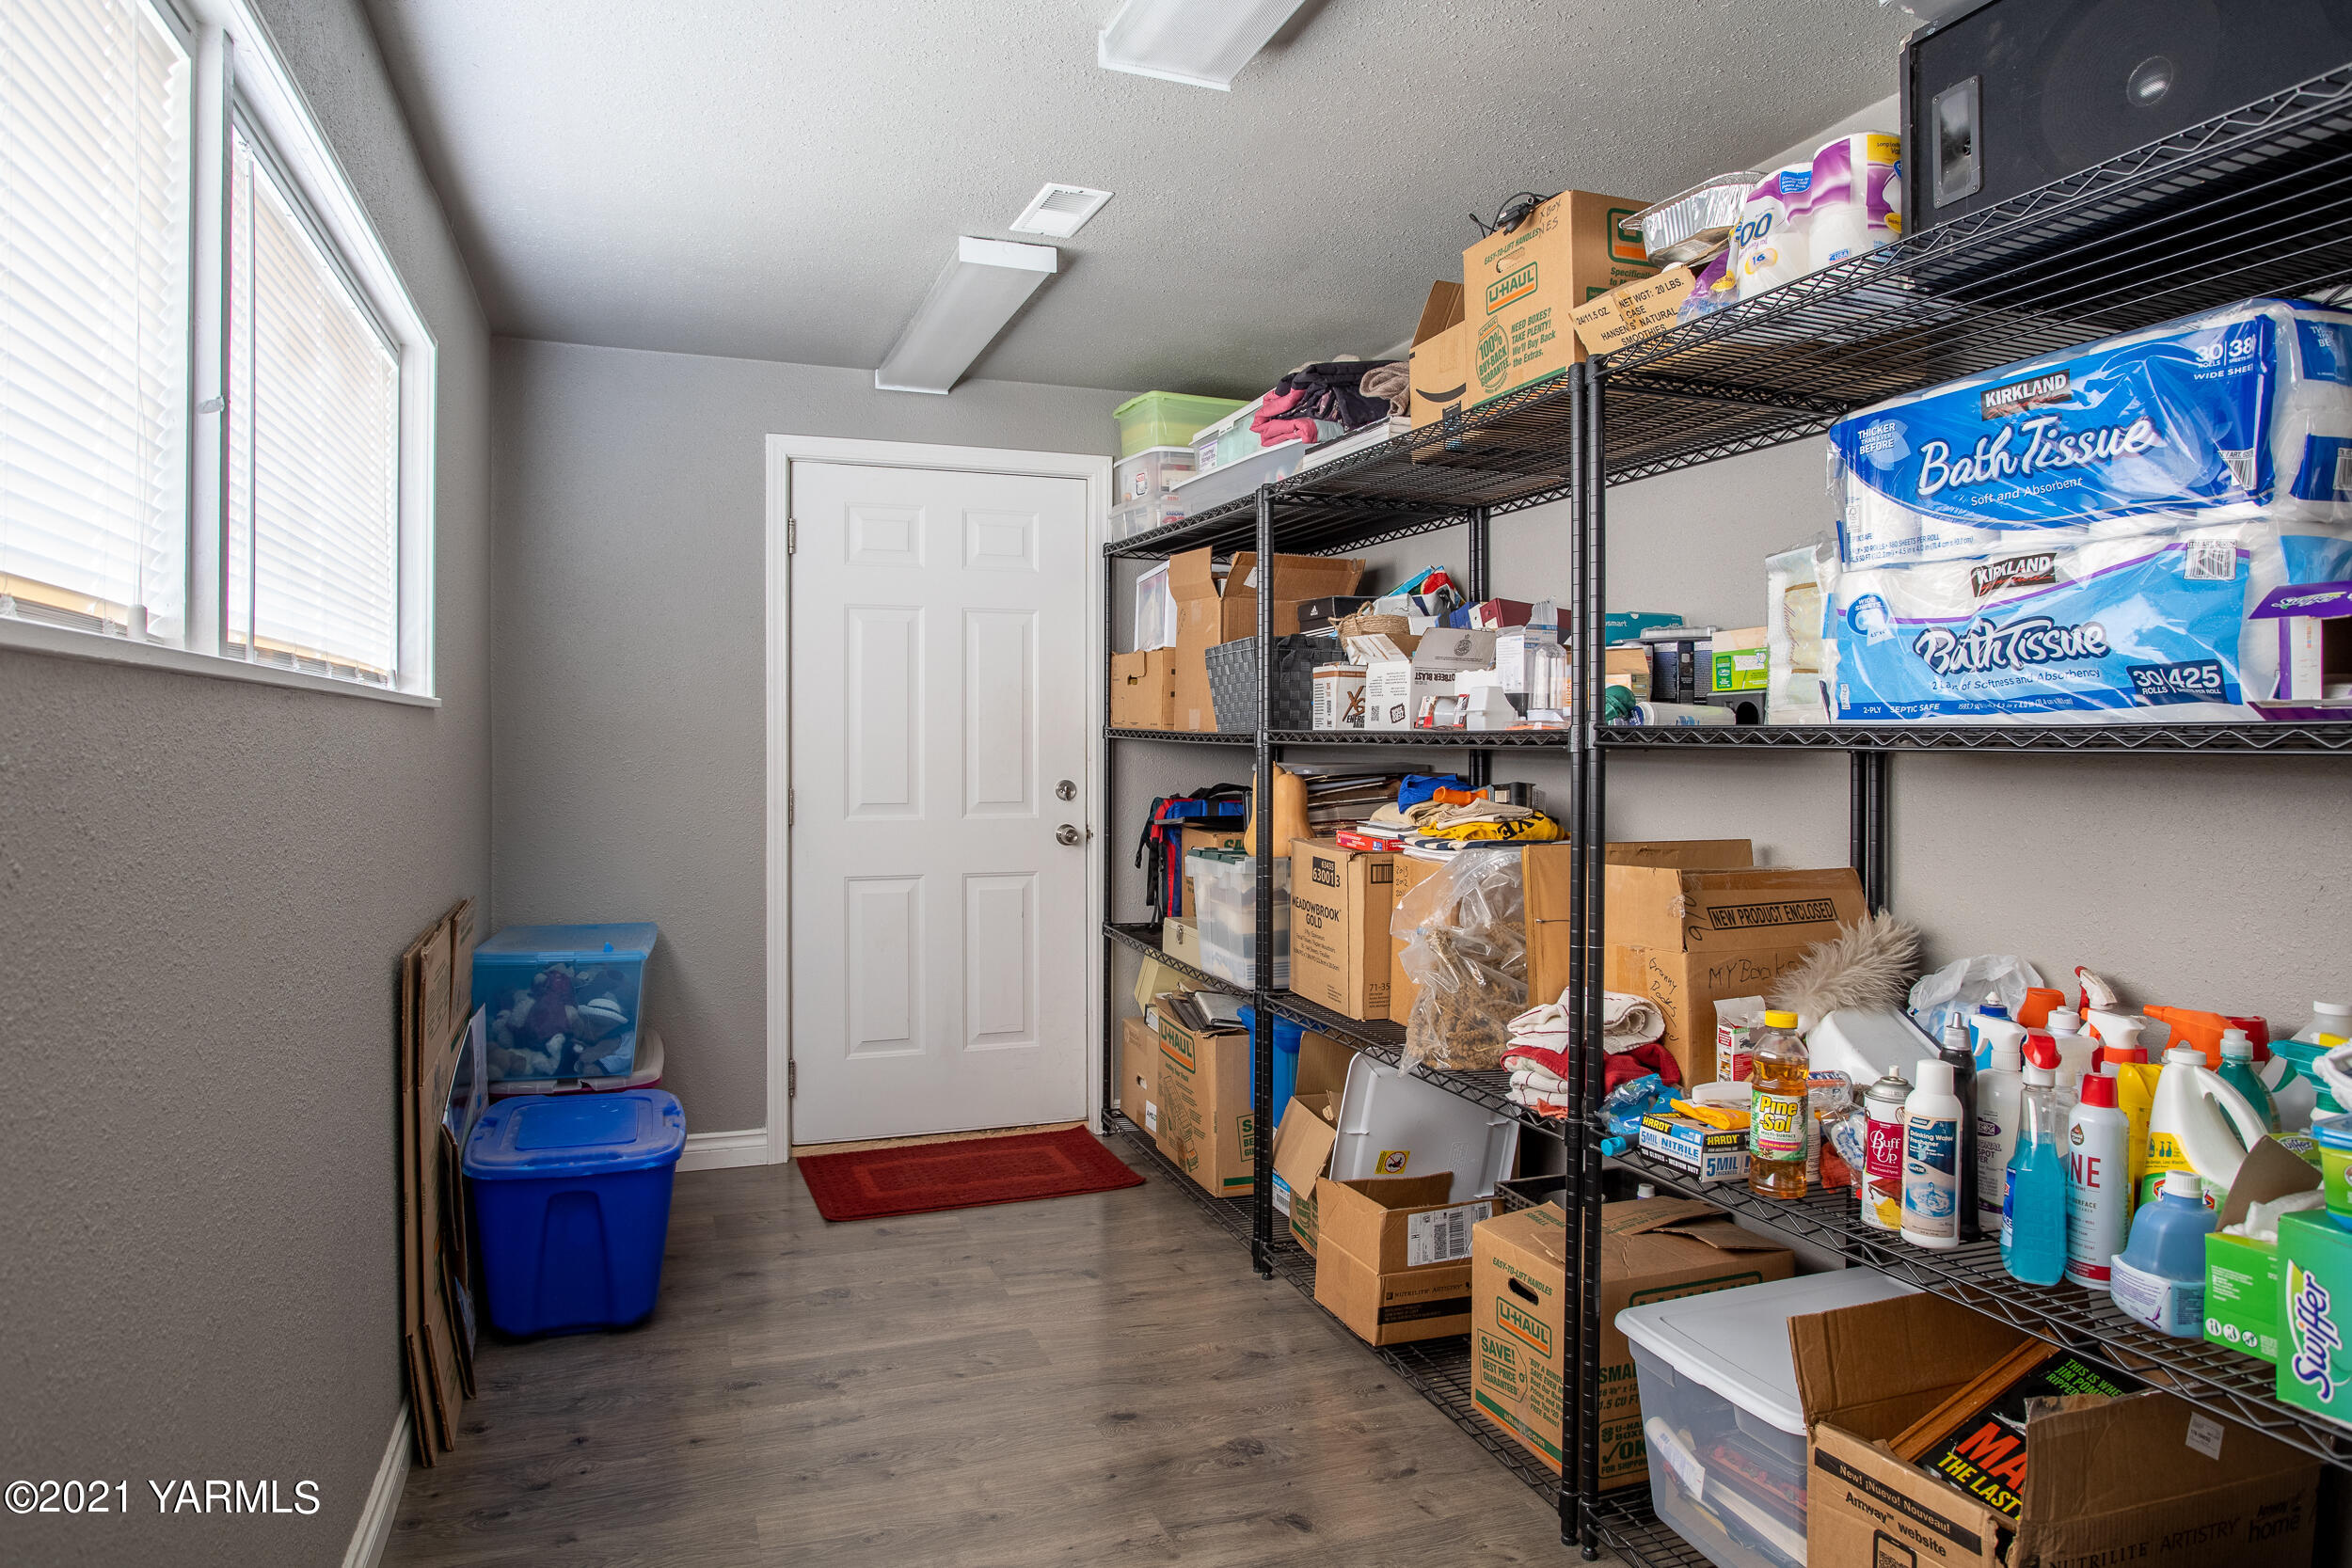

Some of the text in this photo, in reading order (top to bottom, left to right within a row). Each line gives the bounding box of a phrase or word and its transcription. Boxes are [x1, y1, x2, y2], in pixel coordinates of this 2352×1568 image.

[1515, 228, 1539, 247] HANDLES
[1753, 254, 1765, 264] 16
[1488, 269, 1534, 302] U-HAUL
[1618, 296, 1633, 309] NET
[1655, 285, 1664, 294] 20
[1666, 277, 1684, 291] LBS.
[1511, 308, 1551, 334] NEED BOXES?
[1626, 306, 1646, 319] CASE
[1639, 308, 1678, 327] NATURAL
[1511, 320, 1551, 344] TAKE PLENTY!
[1528, 338, 1538, 353] Buy
[1540, 330, 1556, 344] Back
[1621, 324, 1667, 346] SMOOTHIES
[1479, 329, 1502, 360] 100%
[2195, 343, 2224, 363] 30
[1479, 344, 1507, 376] BUY-BACK
[1513, 347, 1544, 368] the Extras.
[2199, 360, 2221, 369] ROLLS
[2193, 370, 2224, 381] WIDE
[1985, 374, 2068, 408] KIRKLAND
[1858, 423, 1896, 440] THICKER
[1861, 436, 1876, 445] THAN
[1859, 439, 1895, 455] BEFORE
[1919, 416, 2157, 496] Bath Tissue
[1971, 478, 2083, 506] Soft and Absorbent
[1917, 535, 1926, 545] PER
[1977, 556, 2051, 584] KIRKLAND
[1855, 601, 1881, 611] SHEETS
[1858, 596, 1875, 606] WIDE
[1915, 616, 2107, 674] Bath Tissue
[1415, 673, 1433, 681] BLAST
[1962, 682, 1971, 691] of
[1974, 677, 2014, 689] Softness
[2016, 675, 2034, 684] and
[2133, 665, 2221, 689] 30 425
[2142, 686, 2168, 694] ROLLS
[1890, 705, 1915, 714] SEPTIC
[1322, 860, 1334, 871] 63435
[1292, 895, 1340, 922] MEADOWBROOK
[1711, 902, 1835, 927] NEW PRODUCT ENCLOSED
[1306, 913, 1322, 929] GOLD
[1160, 1023, 1192, 1058] U-HAUL
[1759, 1095, 1798, 1116] Pine
[1643, 1116, 1670, 1132] HARDY
[1244, 1138, 1254, 1148] BE
[1707, 1133, 1739, 1146] HARDY
[1870, 1130, 1900, 1148] Buff
[1909, 1130, 1934, 1141] Drinking
[1909, 1137, 1939, 1148] Freshener
[1661, 1137, 1699, 1158] NITRILE
[1649, 1150, 1664, 1162] GLOVES
[1688, 1164, 1699, 1175] DUTY
[1492, 1257, 1552, 1296] EASY-TO-LIFT HANDLES
[1500, 1302, 1549, 1344] U-HAUL
[2294, 1272, 2341, 1402] Swiffer
[1481, 1336, 1515, 1365] SAVE!
[1482, 1359, 1517, 1383] BEST PRICE
[1530, 1367, 1557, 1390] SAVE EVEN
[2054, 1367, 2074, 1383] JIM
[2064, 1358, 2089, 1376] THIS
[2089, 1371, 2100, 1384] IS
[1530, 1402, 1542, 1417] FREE
[1615, 1397, 1626, 1407] CU
[1956, 1422, 2027, 1495] MA
[1602, 1465, 1615, 1474] FOR
[1938, 1451, 2022, 1513] THE LAST
[1839, 1465, 1950, 1534] New! ¡Nuevo! Nouveau!
[1898, 1522, 1947, 1557] website
[2160, 1520, 2235, 1552] ARTISTRY
[2249, 1514, 2299, 1544] home
